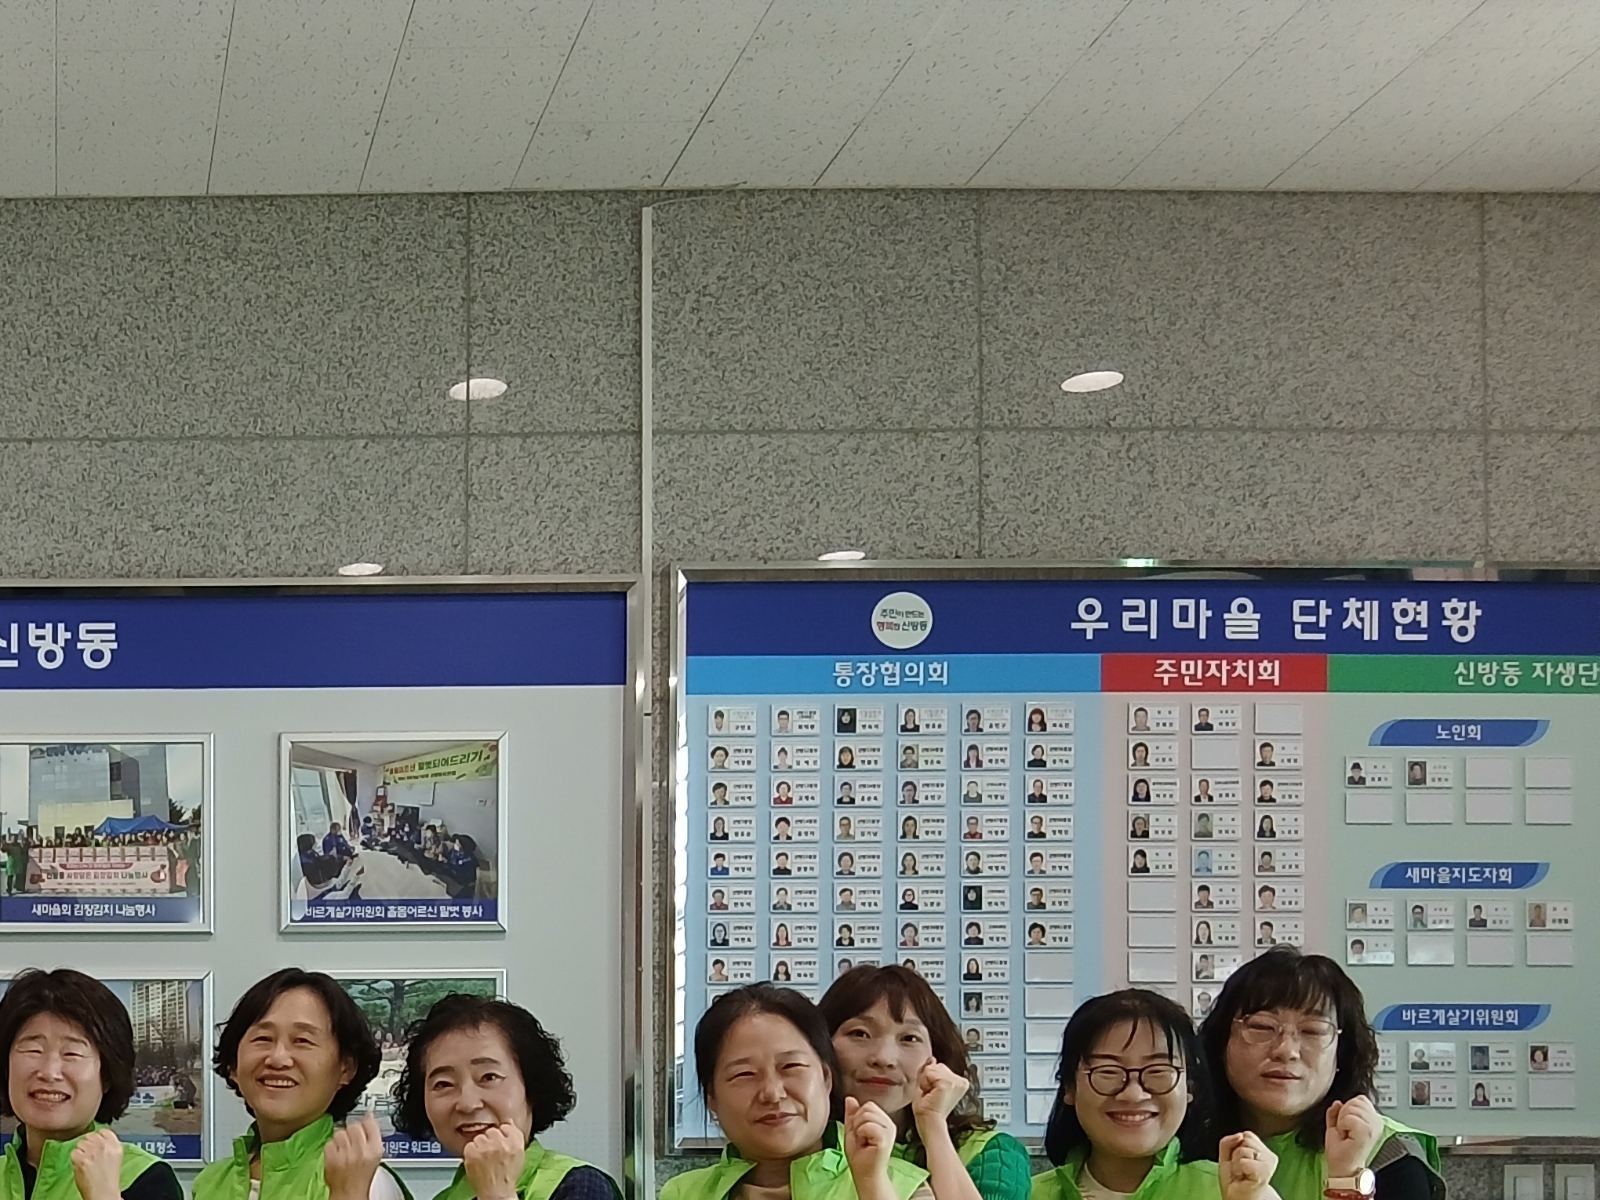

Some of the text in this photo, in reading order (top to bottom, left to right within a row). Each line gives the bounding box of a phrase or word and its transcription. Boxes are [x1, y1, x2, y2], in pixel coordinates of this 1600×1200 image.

[1070, 597, 1482, 643] 우리마을 단체현황
[832, 661, 950, 688] 통장협의회
[1153, 659, 1281, 687] 주민자치회
[1454, 661, 1522, 687] 신방동
[1436, 724, 1482, 742] 노인회
[1405, 867, 1513, 884] 새마을지도자회
[31, 903, 156, 917] 새마을회 김장김치 나눔행사
[1402, 1009, 1519, 1026] 바르게살기위원회
[145, 1141, 176, 1154] 대청소
